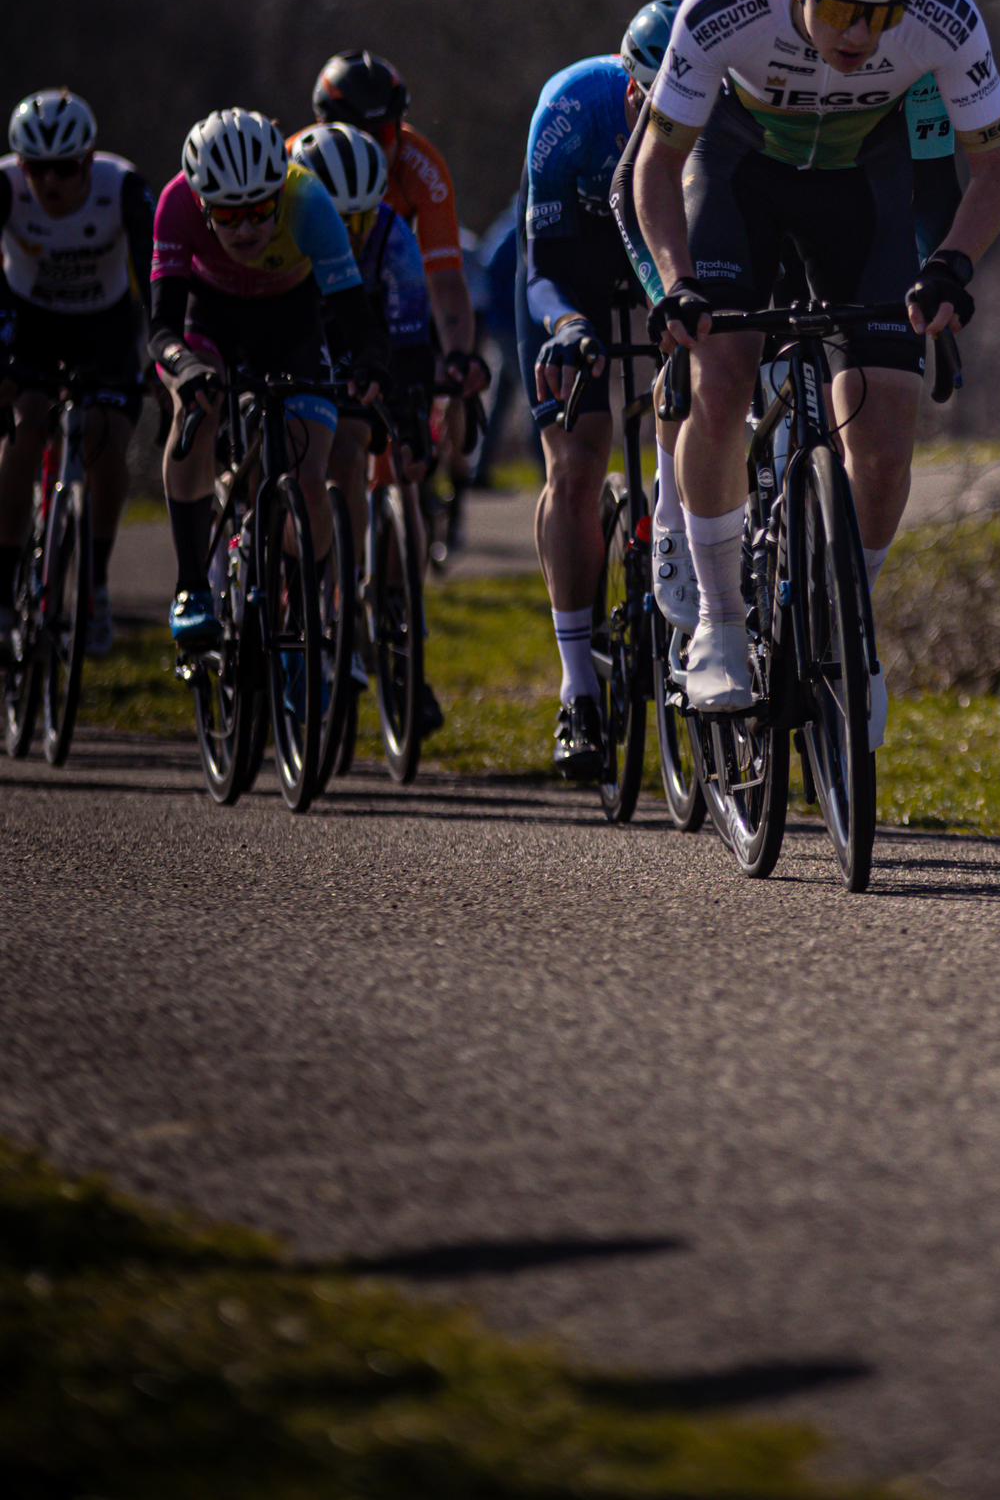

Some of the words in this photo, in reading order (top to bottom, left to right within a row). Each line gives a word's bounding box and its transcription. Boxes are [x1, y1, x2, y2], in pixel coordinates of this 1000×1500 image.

[653, 110, 673, 132] EGG
[531, 115, 572, 173] HABOVO
[613, 208, 639, 258] SCOTT
[695, 260, 742, 273] Produlab
[696, 269, 736, 280] Pharma
[867, 321, 907, 333] Pharma
